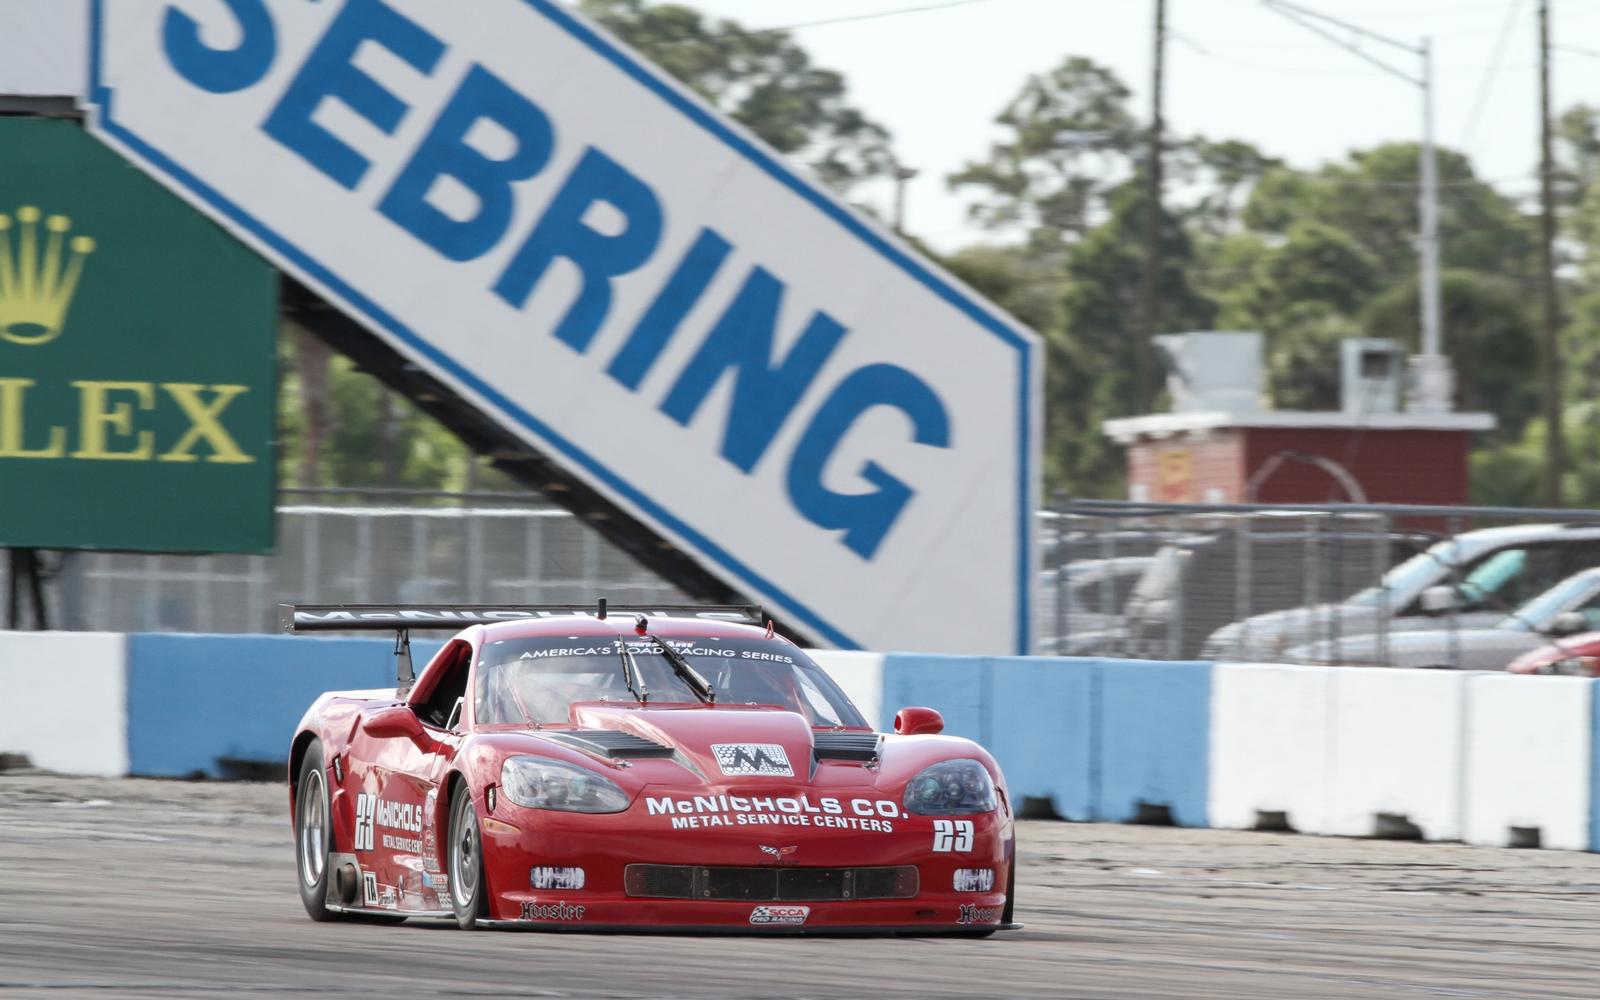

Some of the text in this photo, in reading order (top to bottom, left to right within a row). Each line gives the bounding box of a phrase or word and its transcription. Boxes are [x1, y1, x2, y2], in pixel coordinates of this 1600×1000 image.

[161, 0, 952, 562] SEBRING
[519, 647, 611, 660] AMERICA'S
[741, 651, 793, 664] SERIES
[376, 799, 422, 832] McNICHOLS
[645, 794, 909, 819] McNICHOLS CO.
[354, 793, 377, 850] 23
[671, 813, 893, 833] METAL SERVICE CENTERS
[932, 820, 975, 852] 23
[520, 900, 586, 920] Hoosier
[769, 908, 805, 917] SCCA
